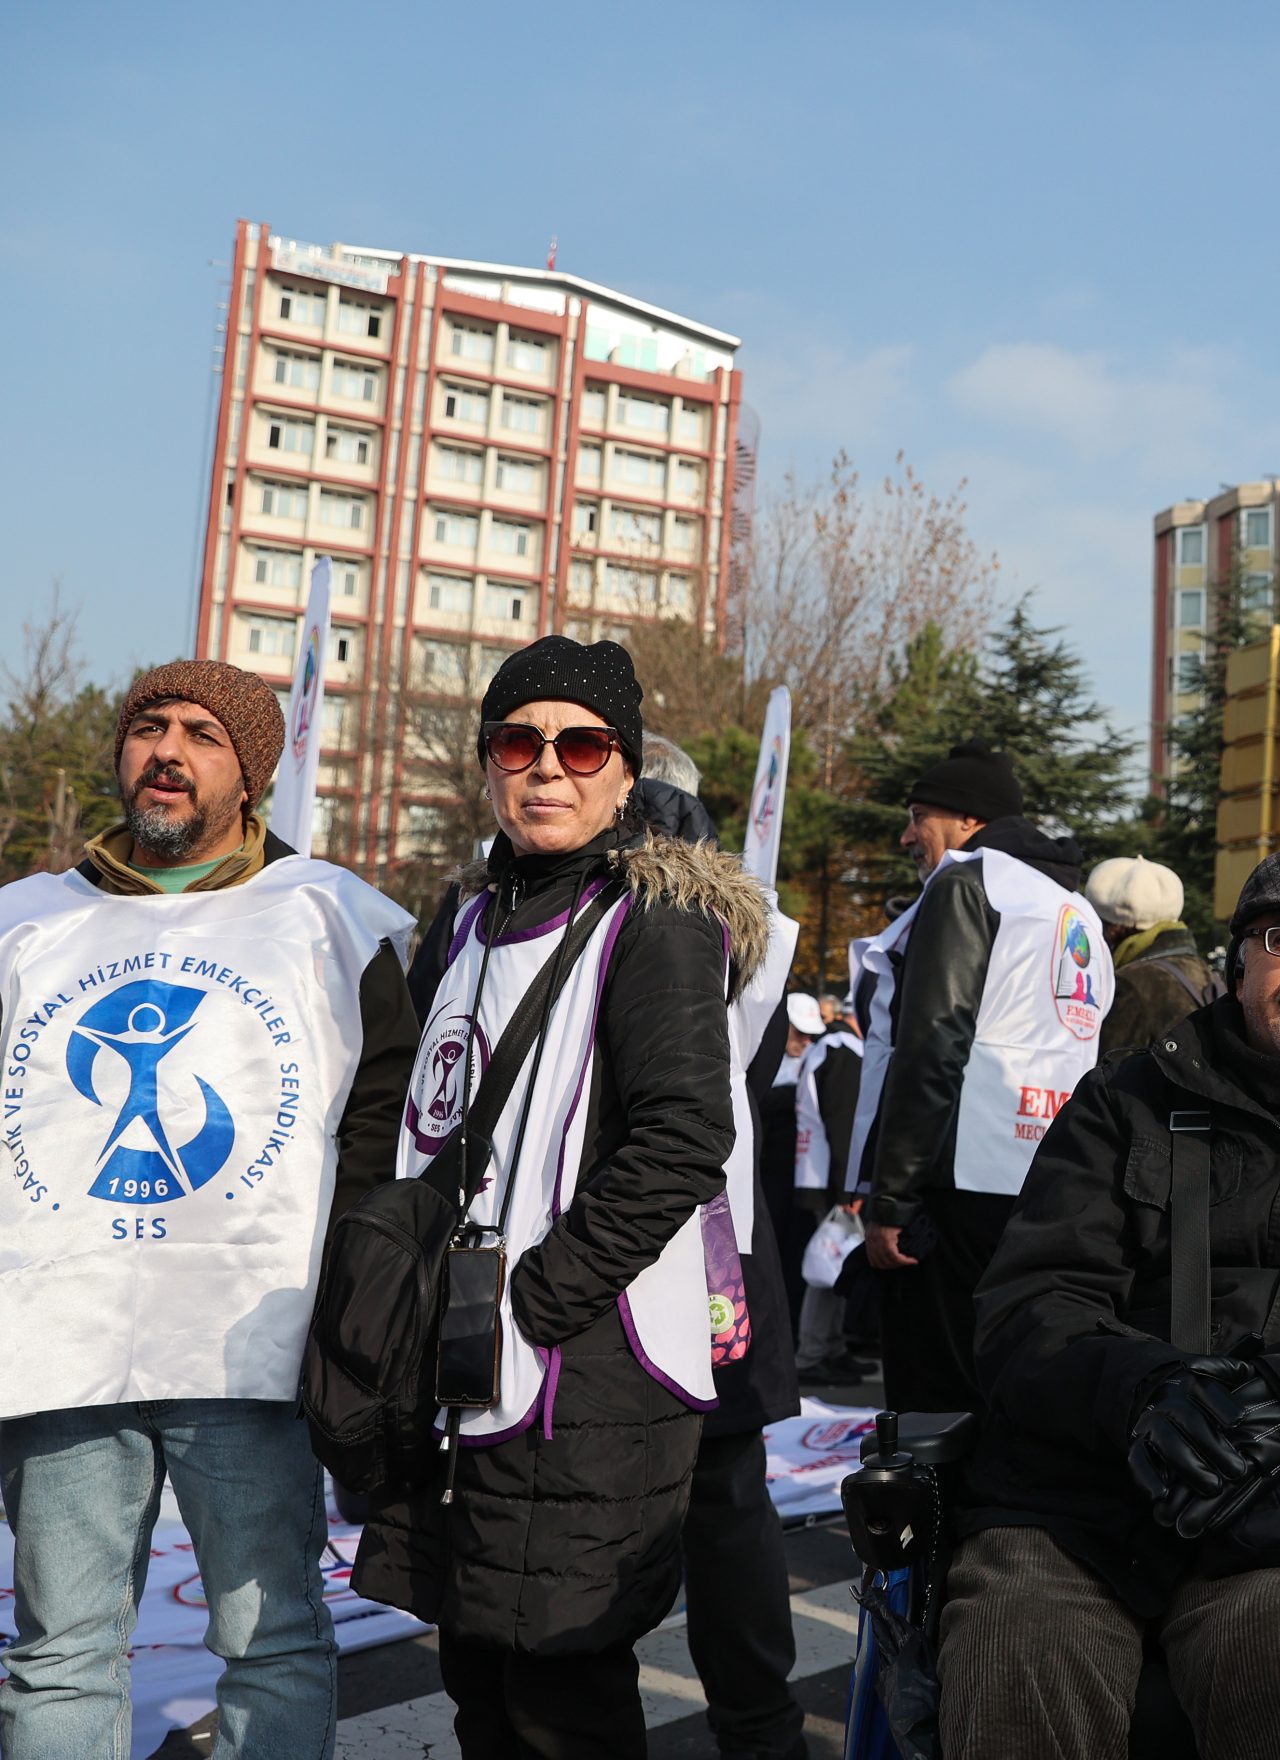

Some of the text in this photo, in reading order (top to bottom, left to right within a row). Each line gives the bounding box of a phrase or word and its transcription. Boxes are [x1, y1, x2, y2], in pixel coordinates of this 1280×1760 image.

[4, 952, 300, 1203] SAĞLIK VE SOSYAL HİZMET EMEKÇİLER SENDİKASI
[430, 1123, 441, 1132] SES
[107, 1177, 170, 1198] 1996
[112, 1217, 168, 1240] SES
